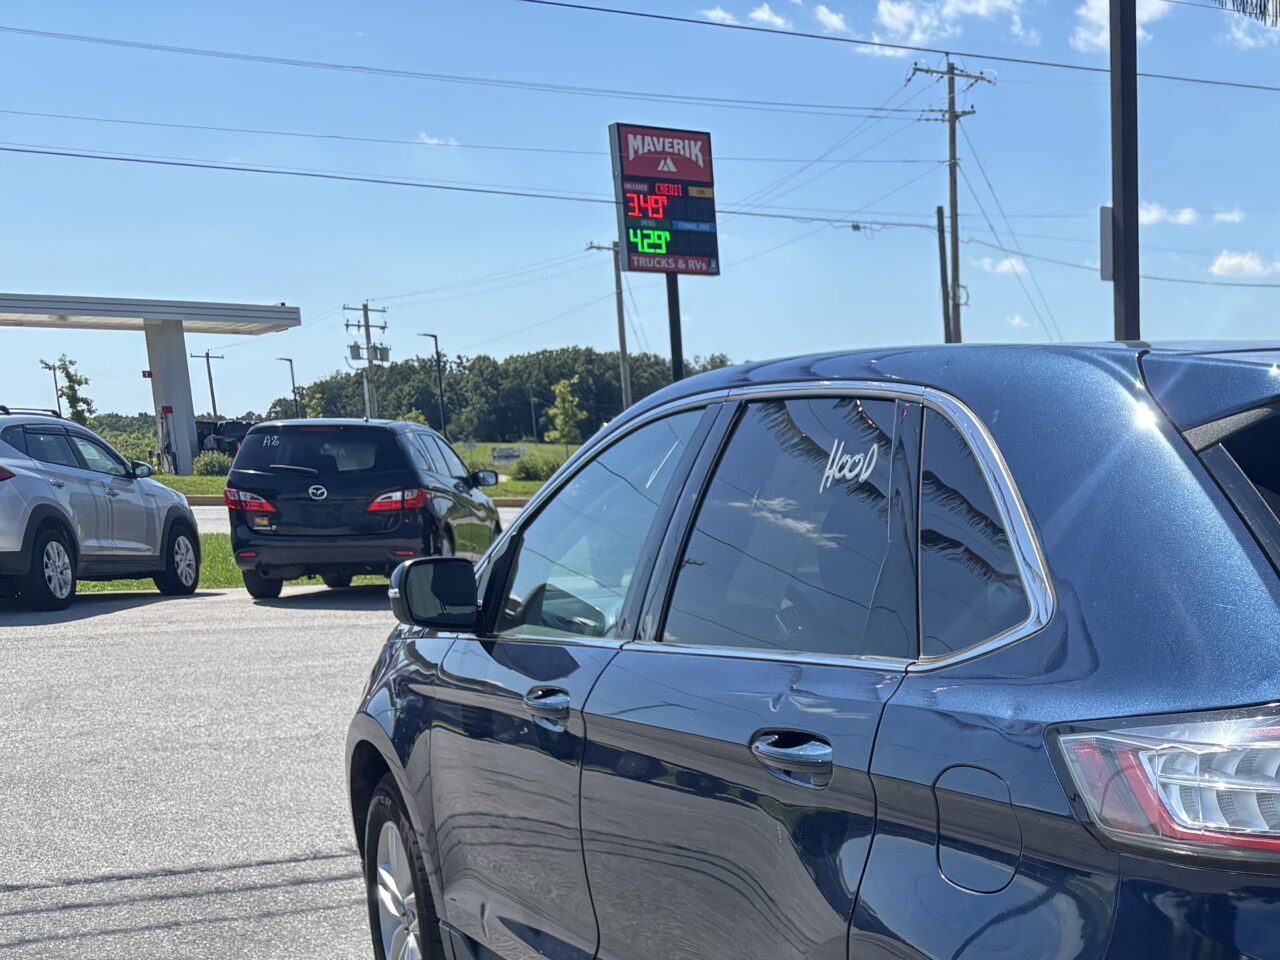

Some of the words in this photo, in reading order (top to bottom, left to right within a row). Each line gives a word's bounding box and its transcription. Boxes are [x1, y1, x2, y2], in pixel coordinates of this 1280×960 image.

[627, 133, 704, 168] MAVERIK
[655, 182, 682, 197] CREDIT
[632, 256, 675, 268] TRUCKS
[677, 259, 686, 269] &
